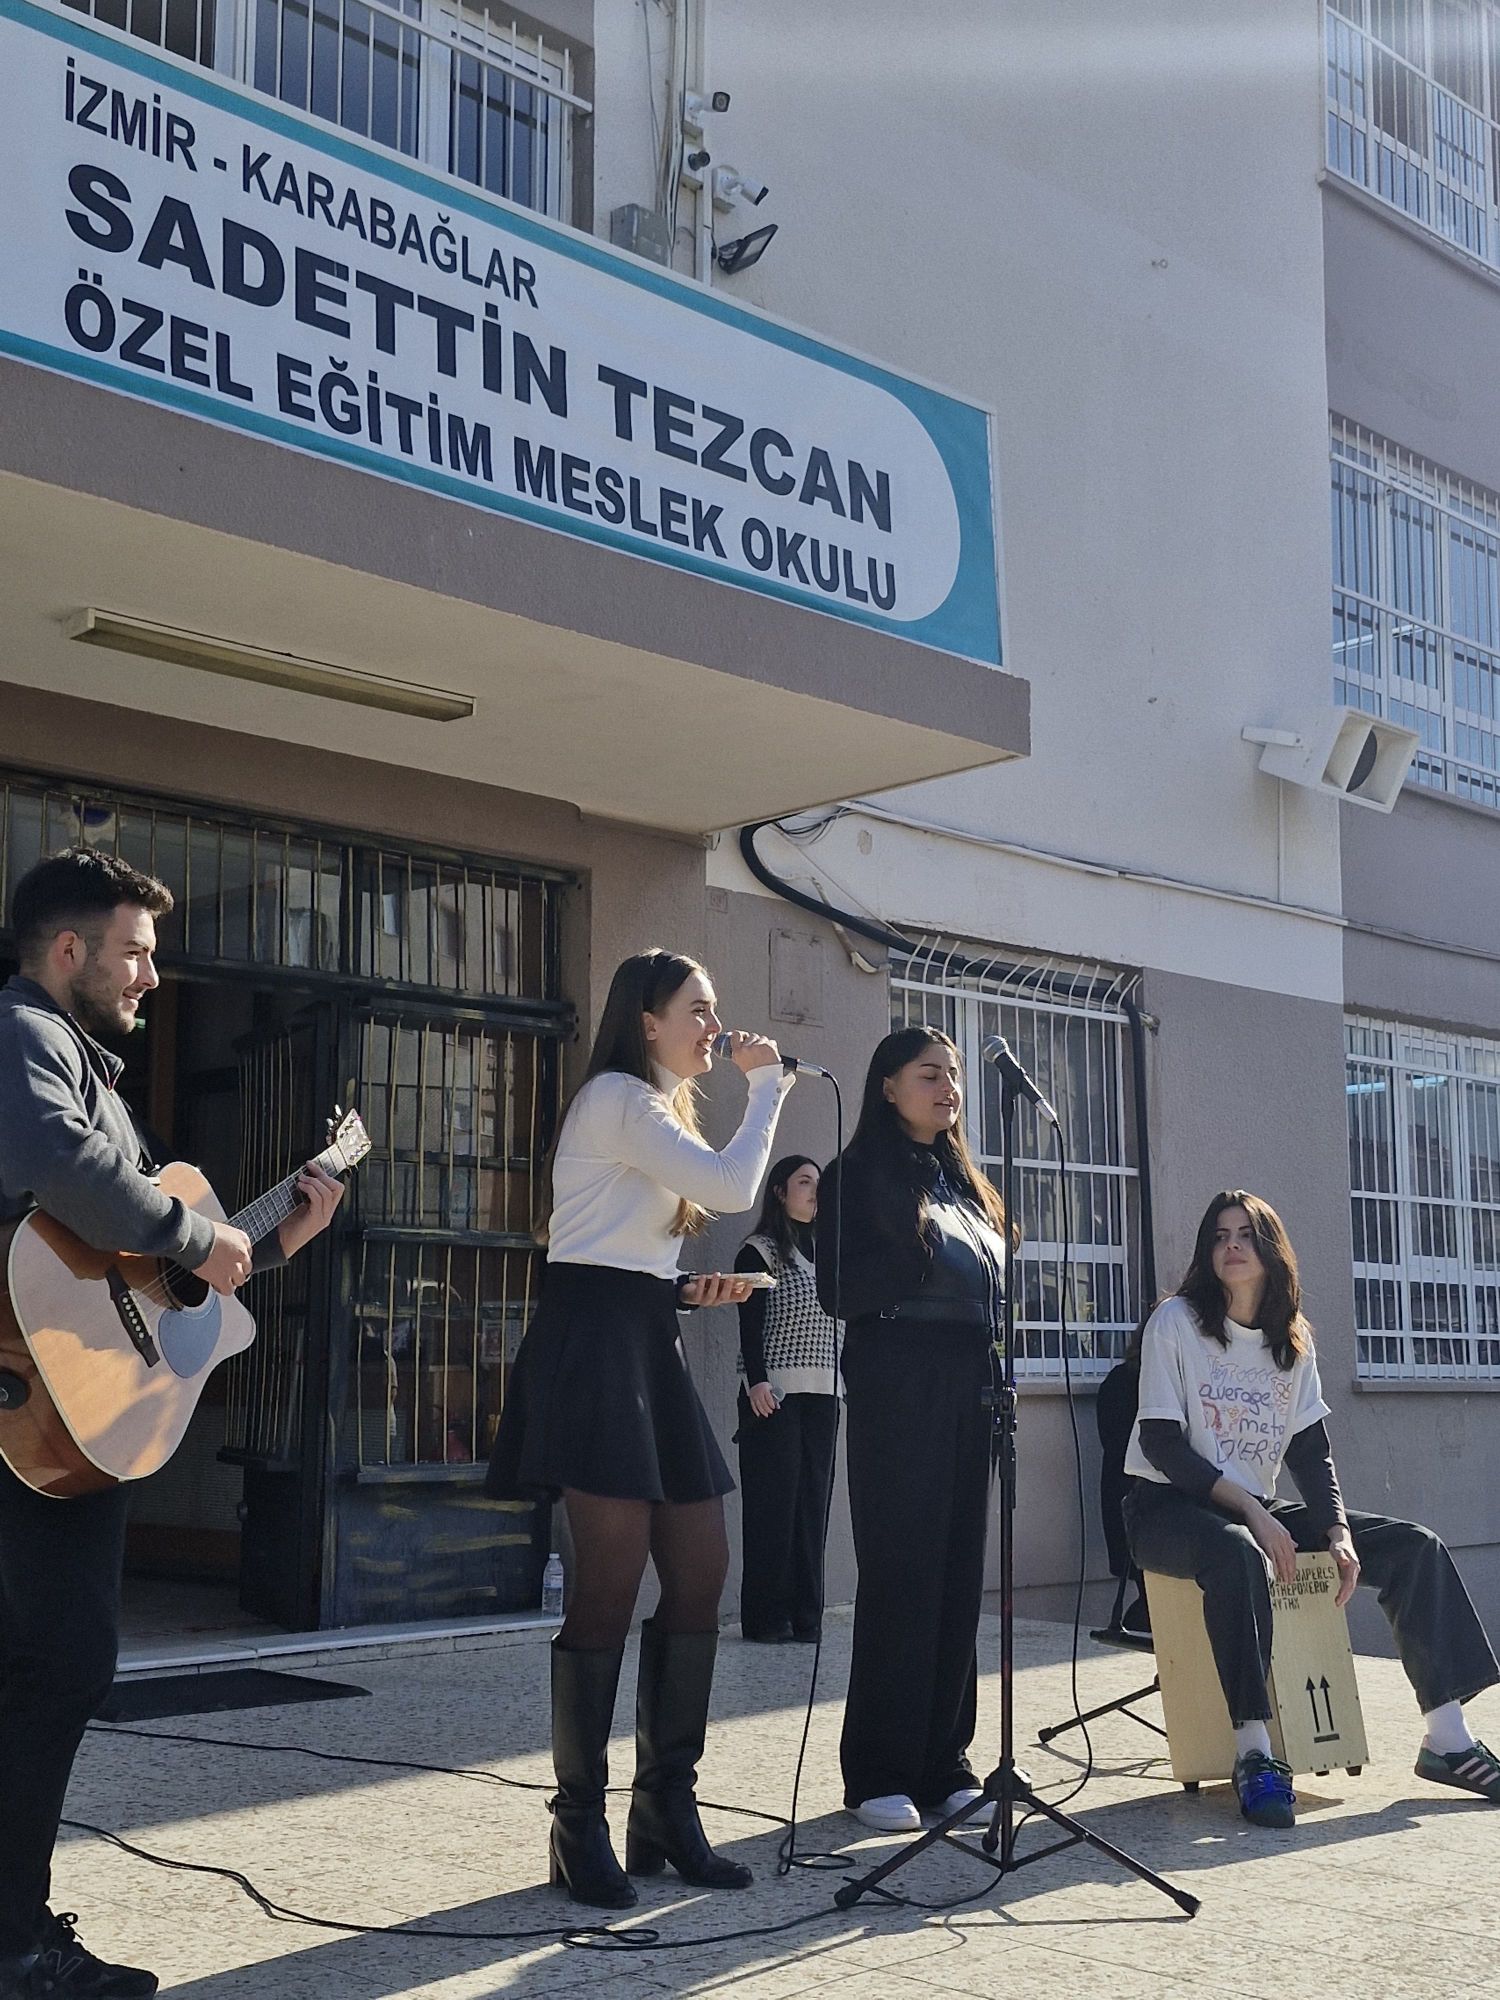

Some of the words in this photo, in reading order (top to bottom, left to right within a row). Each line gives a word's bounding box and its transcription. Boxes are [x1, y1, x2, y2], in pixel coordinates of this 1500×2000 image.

[64, 163, 568, 419] SADETTİN
[597, 363, 892, 534] TEZCAN
[65, 56, 198, 173] İZMİR
[242, 143, 540, 309] KARABAĞLAR
[64, 267, 255, 403] ÖZEL
[276, 352, 494, 483] EĞİTİM
[513, 435, 728, 560] MESLEK
[741, 517, 896, 611] OKULU
